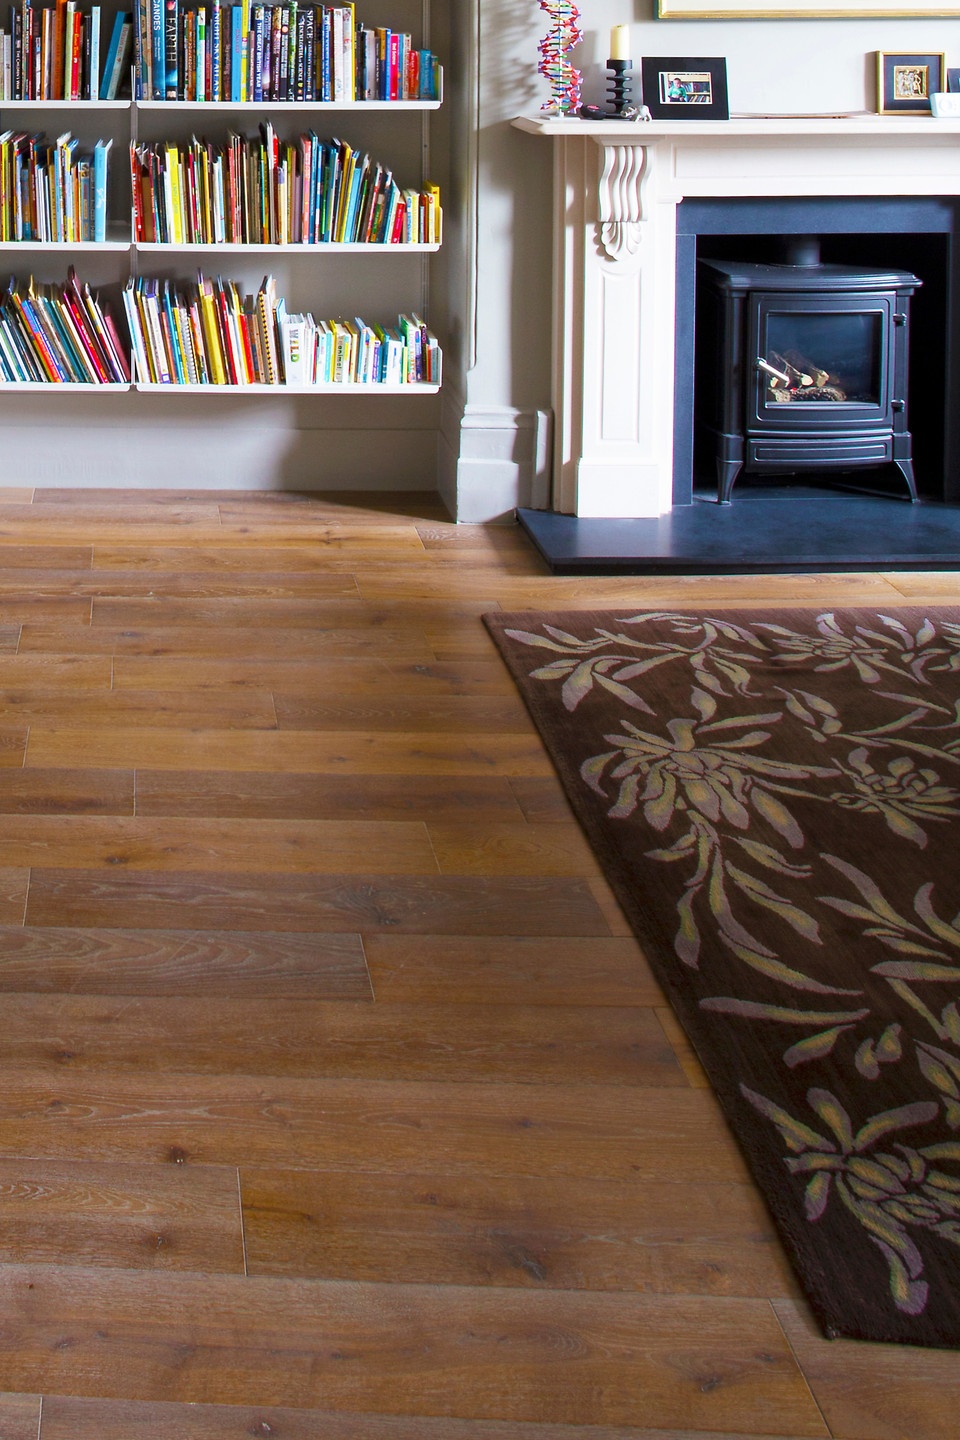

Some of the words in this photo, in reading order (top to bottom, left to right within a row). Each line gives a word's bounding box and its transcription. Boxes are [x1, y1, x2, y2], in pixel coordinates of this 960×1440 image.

[165, 17, 177, 63] EARTH
[306, 9, 314, 39] SPACE
[289, 328, 300, 363] WILD
